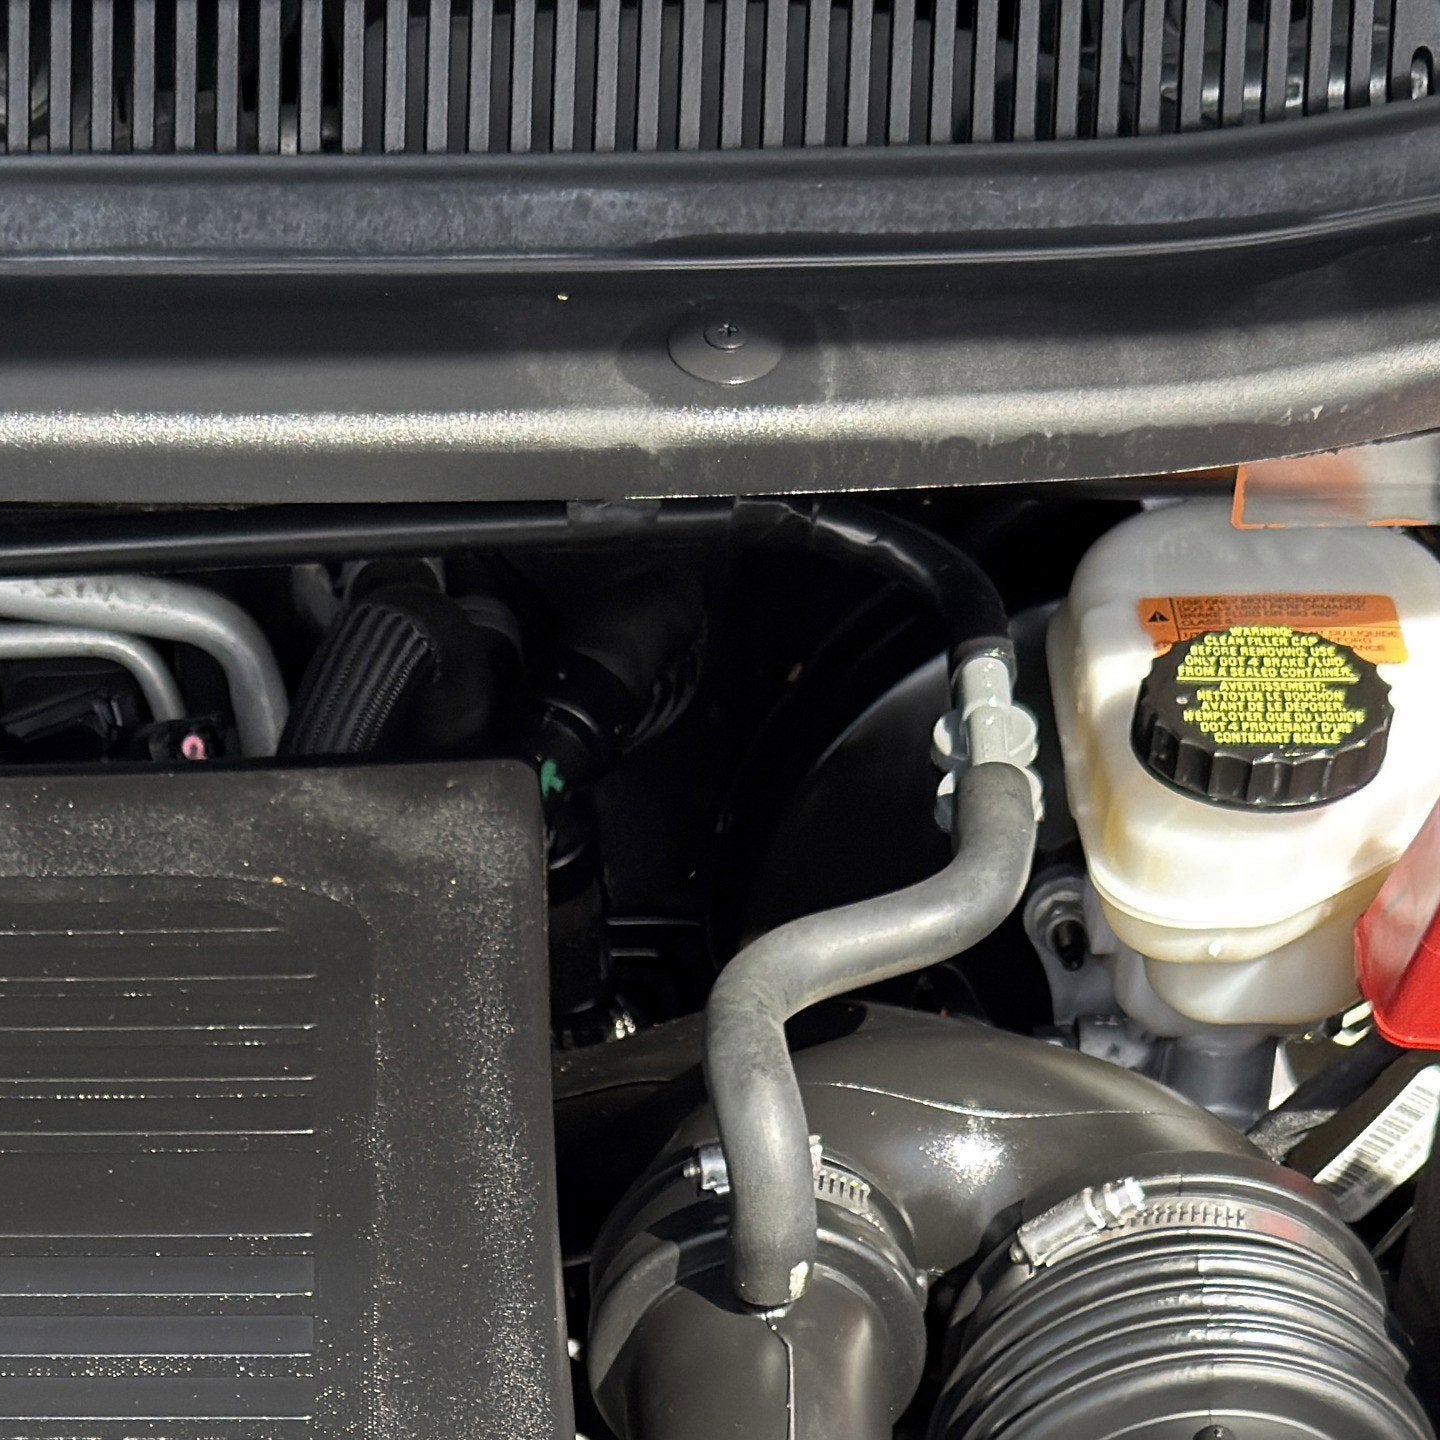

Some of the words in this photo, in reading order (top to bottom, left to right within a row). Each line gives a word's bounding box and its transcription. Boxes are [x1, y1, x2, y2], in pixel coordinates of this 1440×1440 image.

[1204, 636, 1245, 646] CLEAN
[1247, 636, 1289, 646] FILLER
[1292, 636, 1318, 646] CAP
[1190, 646, 1236, 656] BEFORE
[1310, 646, 1335, 657] USE
[1185, 656, 1216, 666] ONLY
[1220, 657, 1245, 666] DOT
[1248, 657, 1259, 667] 4
[1264, 657, 1305, 667] BRAKE
[1308, 657, 1345, 667] FLUID
[1178, 666, 1215, 677] FROM
[1218, 667, 1228, 677] A
[1230, 667, 1278, 677] SEALED
[1197, 690, 1263, 701] NETTOYER
[1266, 691, 1282, 701] LE
[1284, 691, 1345, 701] BOUCHON
[1202, 701, 1245, 711] AVANT
[1248, 701, 1264, 711] DE
[1267, 701, 1283, 711] LE
[1266, 712, 1292, 722] QUE
[1295, 712, 1312, 722] DU
[1315, 712, 1365, 724] LIQUIDE
[1200, 722, 1226, 732] DOT
[1228, 722, 1239, 732] 4
[1242, 722, 1318, 732] PROVENANT
[1215, 732, 1290, 743] CONTENANT
